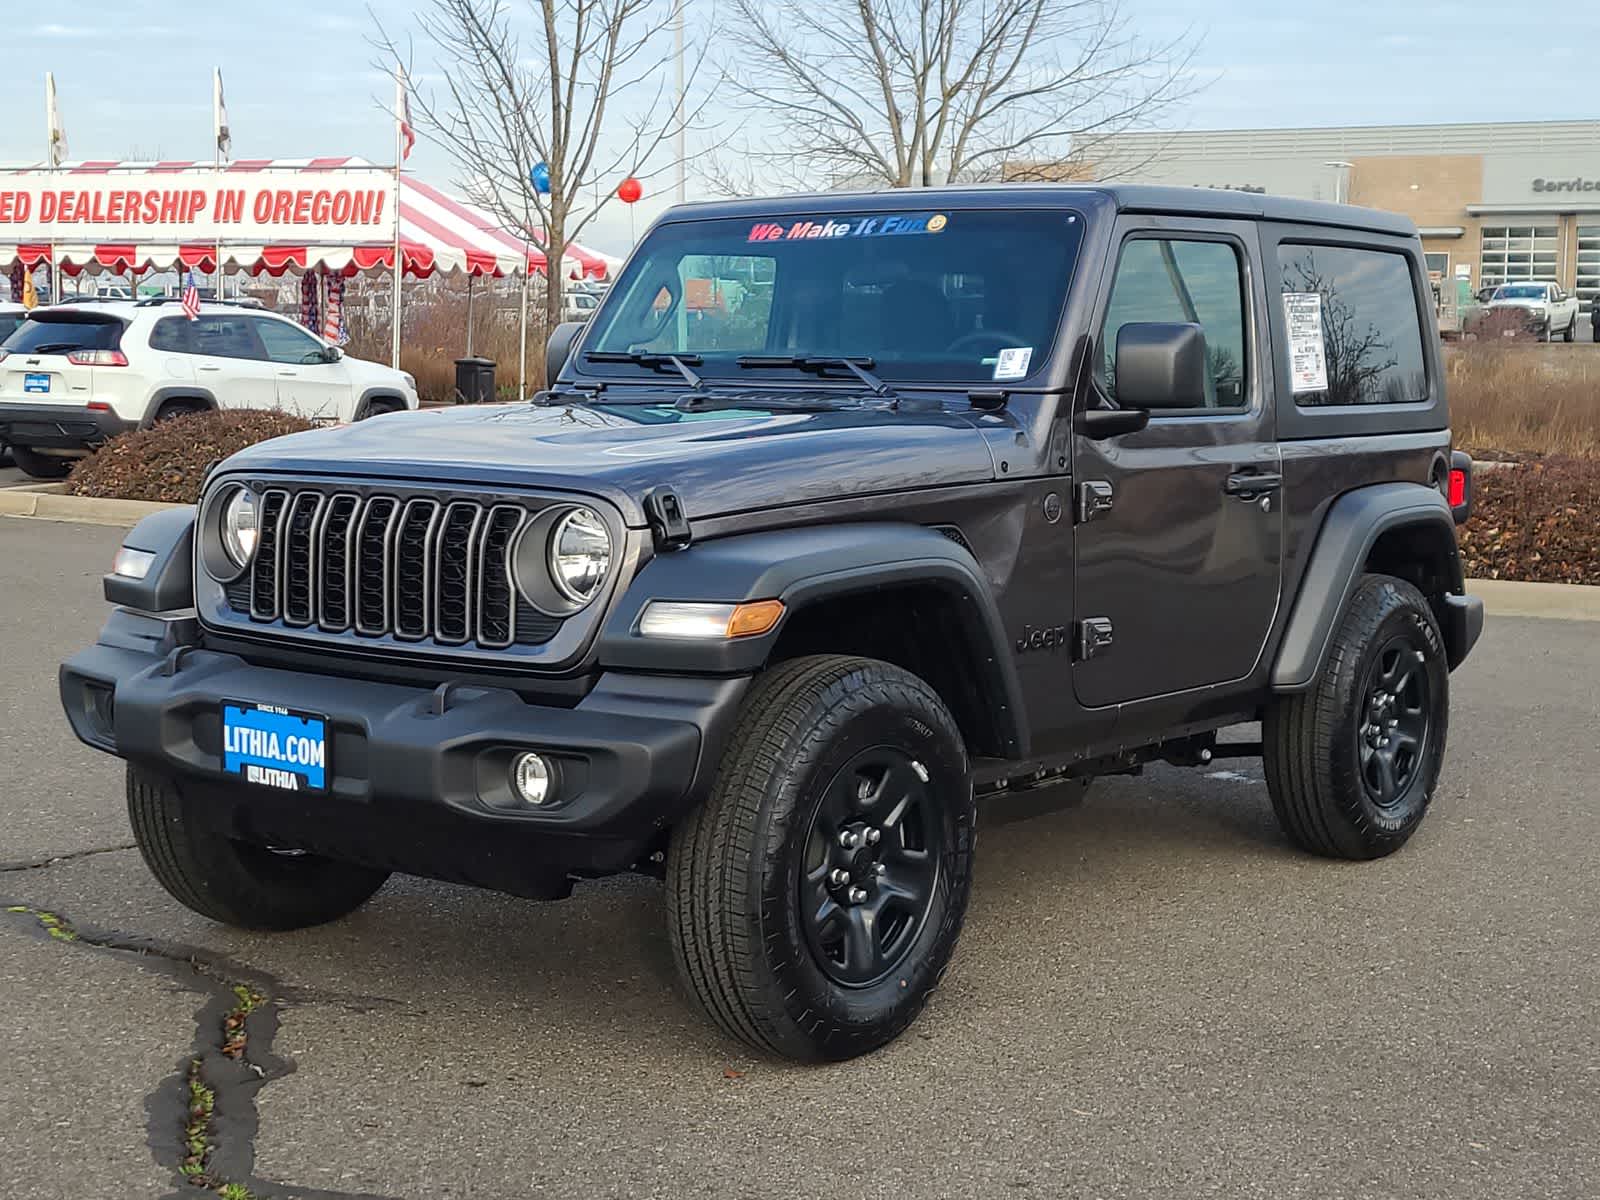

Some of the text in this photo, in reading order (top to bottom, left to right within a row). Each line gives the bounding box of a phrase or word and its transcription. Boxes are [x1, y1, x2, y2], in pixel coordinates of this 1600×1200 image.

[39, 190, 207, 224] DEALERSHIP
[213, 189, 246, 223] IN
[253, 189, 386, 225] OREGON!
[748, 217, 925, 241] We Make It Fun
[1016, 624, 1065, 653] Jeep
[224, 724, 325, 769] LITHIA.COM
[257, 767, 298, 791] LITHIA
